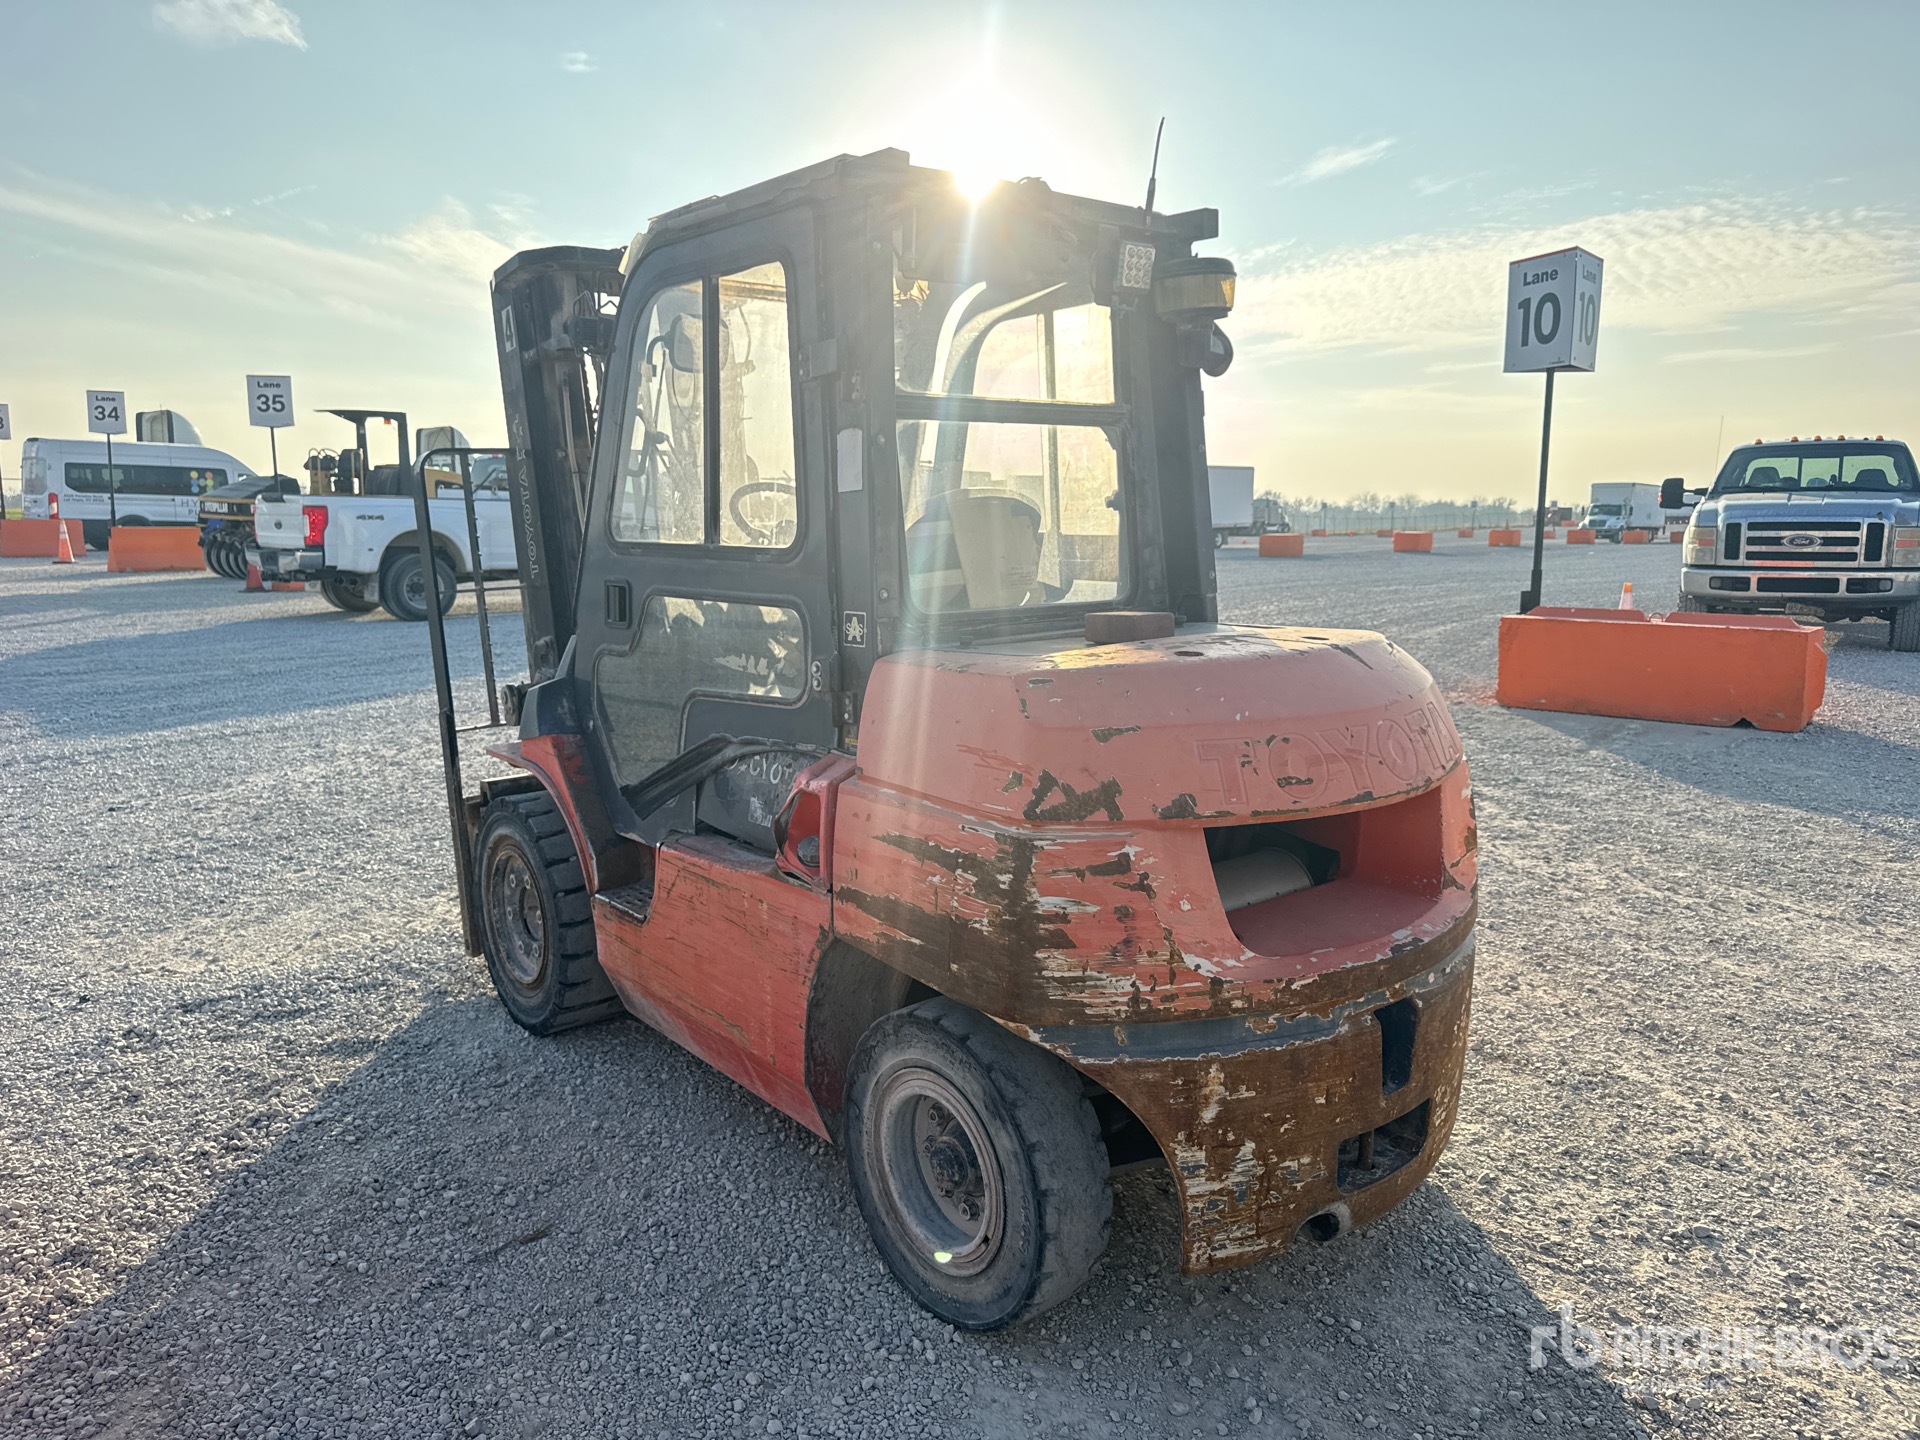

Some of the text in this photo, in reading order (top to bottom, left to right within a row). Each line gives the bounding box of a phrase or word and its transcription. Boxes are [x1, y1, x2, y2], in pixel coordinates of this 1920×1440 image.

[1523, 268, 1559, 287] Lane
[1582, 264, 1597, 285] Lane
[1517, 292, 1562, 348] 10
[1578, 291, 1596, 346] 10
[257, 380, 282, 389] Lane
[94, 405, 120, 421] 34
[256, 393, 286, 413] 35
[517, 465, 540, 579] TOYOTA
[1196, 701, 1460, 806] TOYOTA
